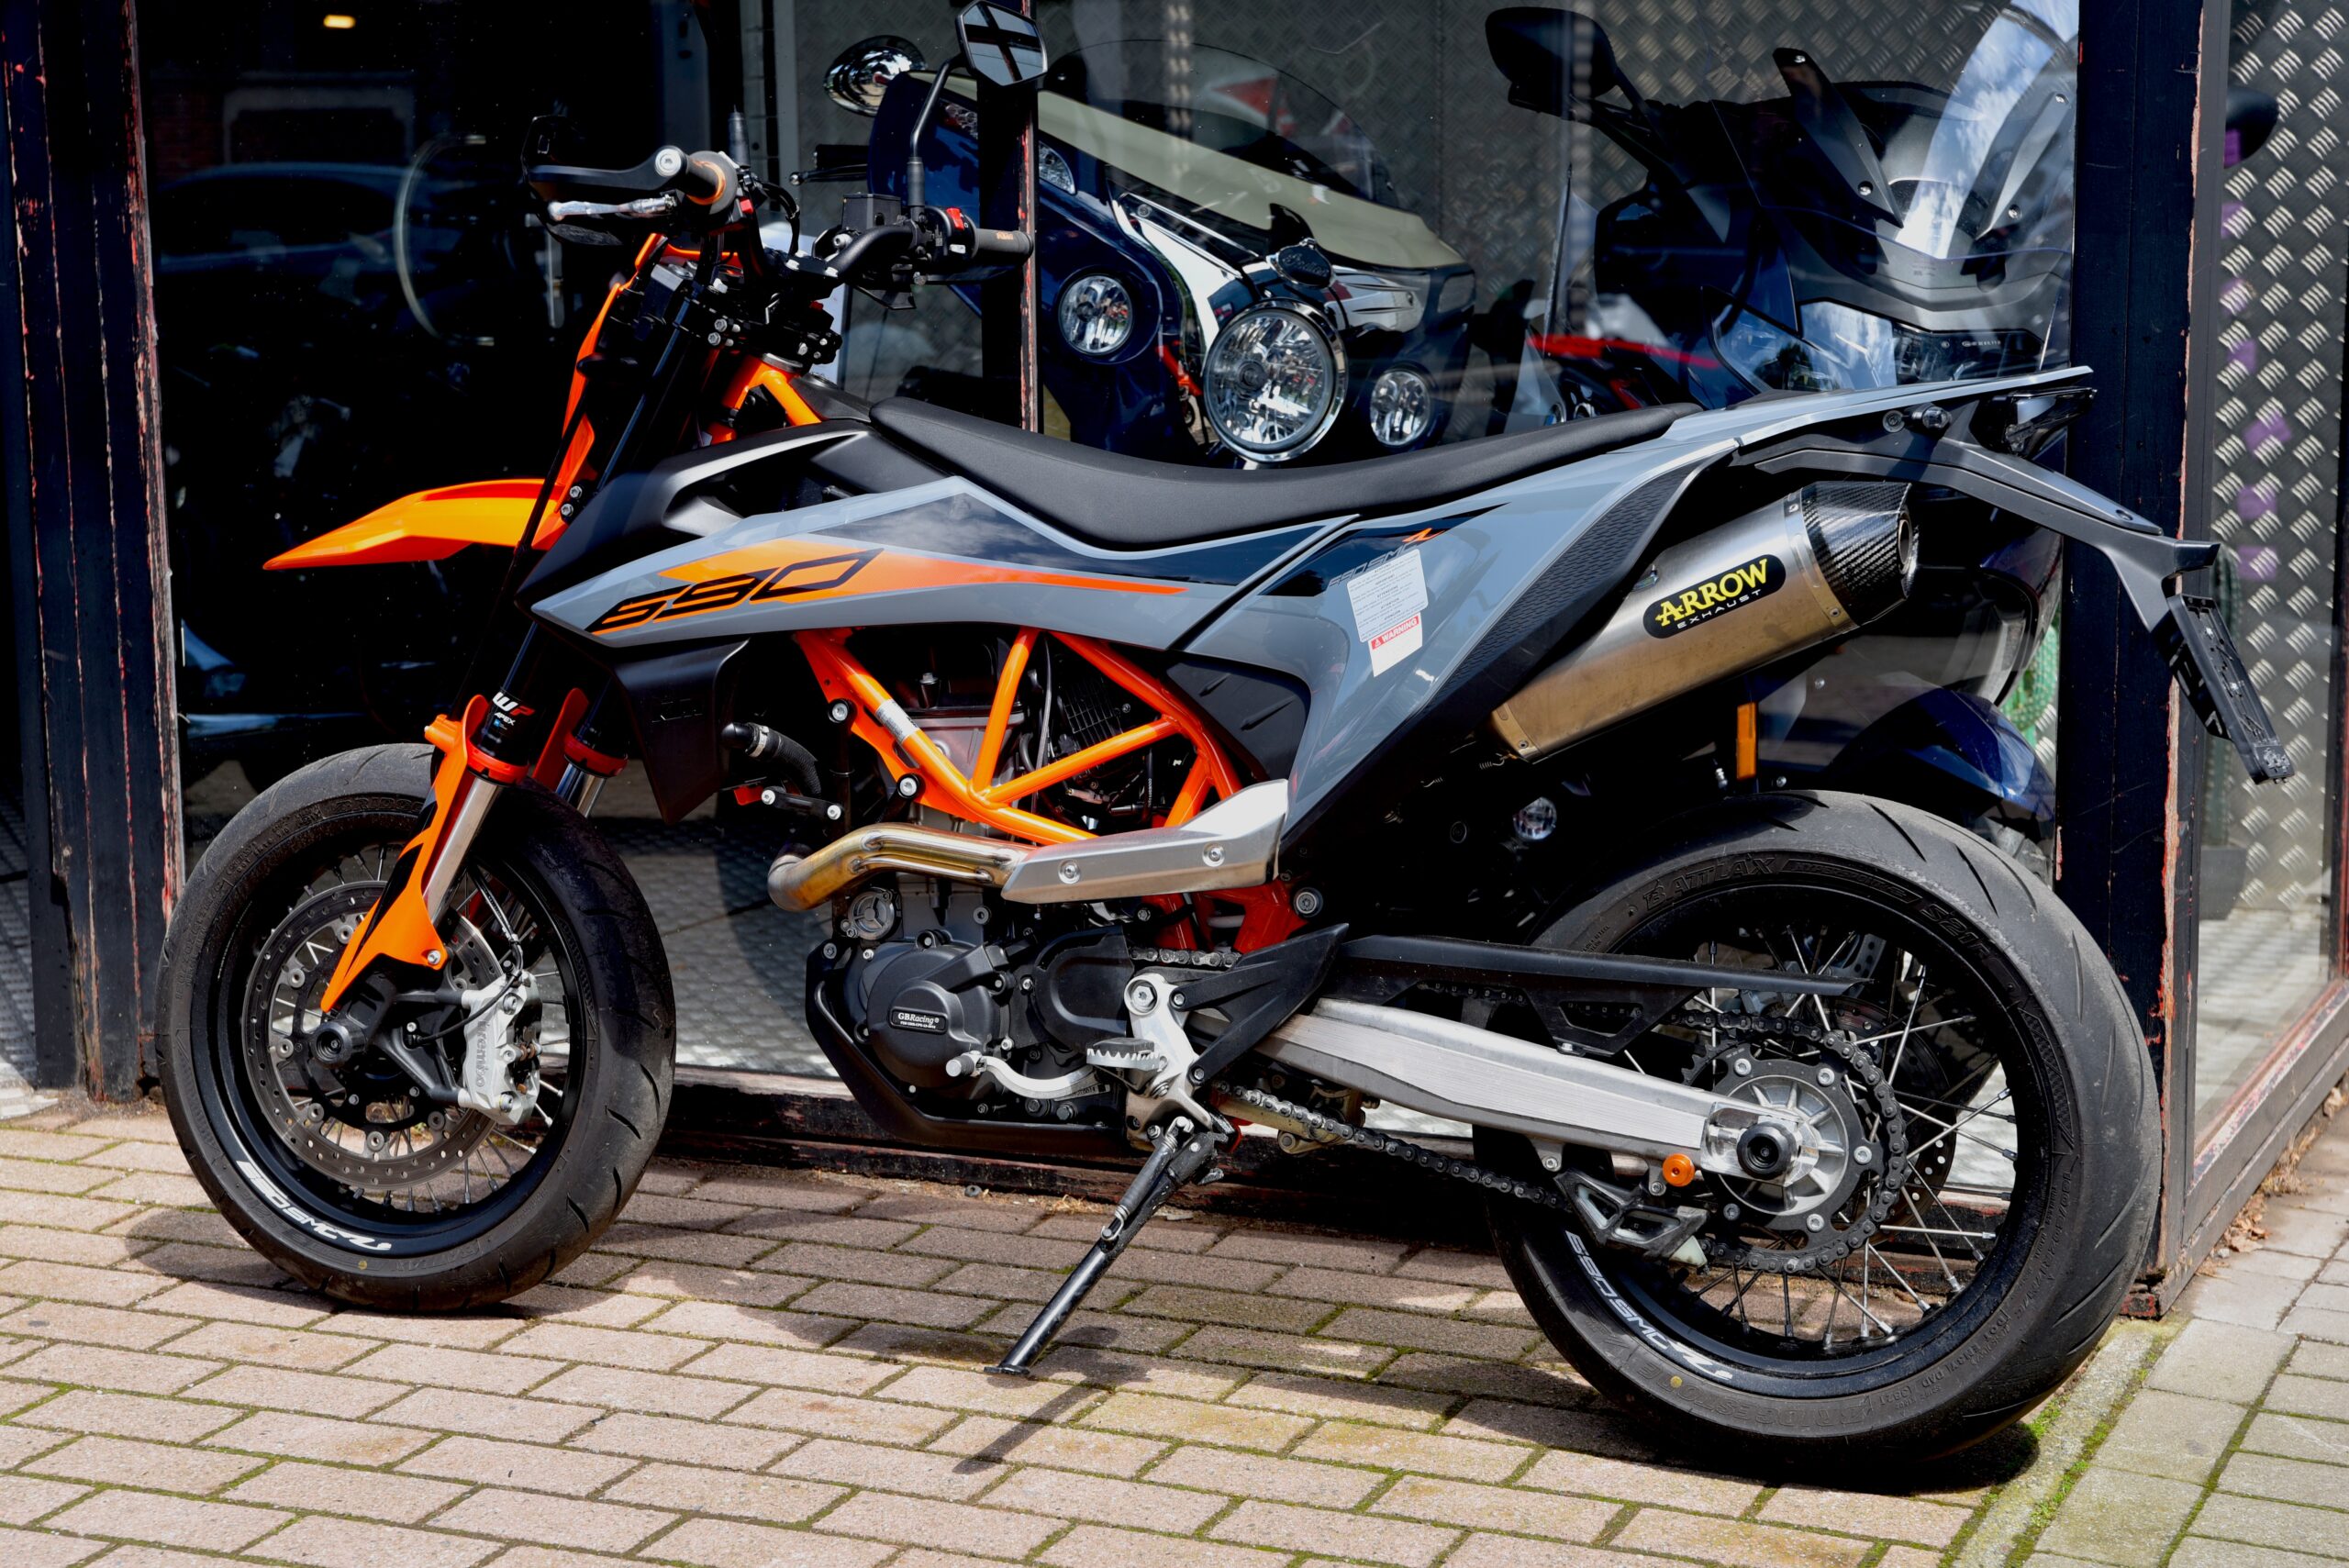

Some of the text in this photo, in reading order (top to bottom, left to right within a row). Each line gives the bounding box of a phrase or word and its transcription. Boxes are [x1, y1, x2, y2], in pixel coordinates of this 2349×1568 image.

[588, 549, 884, 634] 690
[1655, 558, 1767, 627] ARROW
[1677, 589, 1762, 629] EXHAUST
[1381, 617, 1418, 643] WARNING
[493, 691, 535, 716] WP
[476, 1020, 489, 1088] brembo
